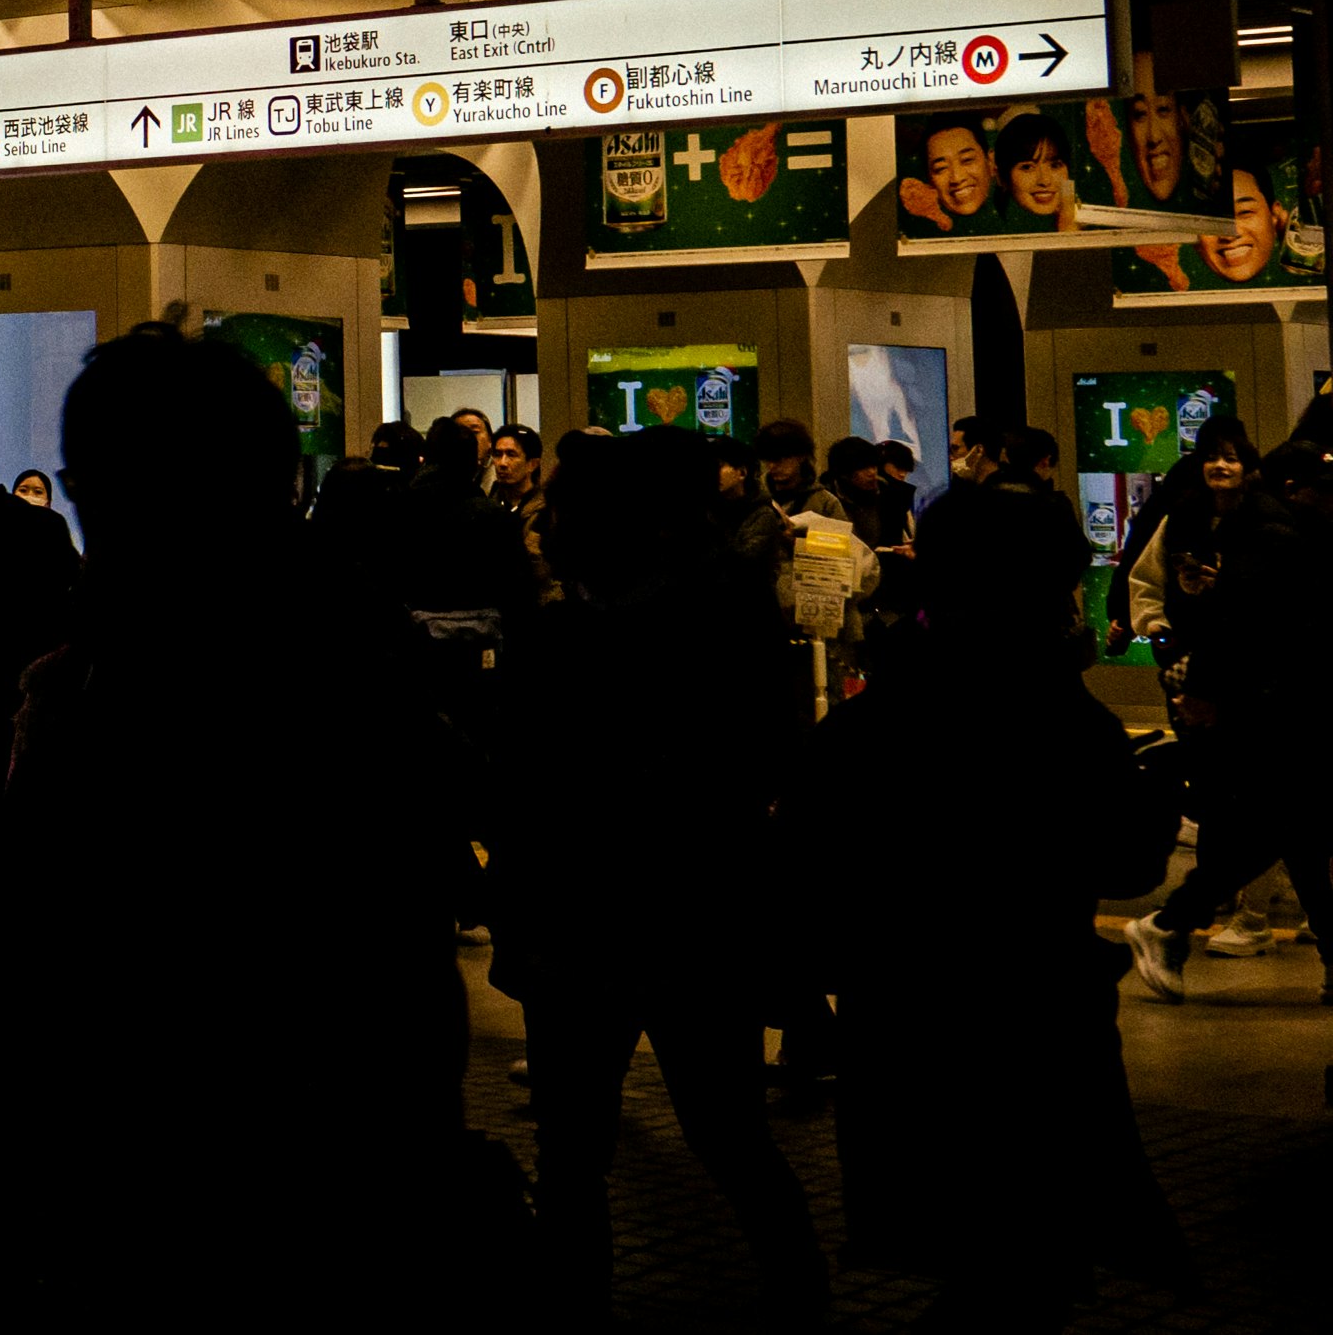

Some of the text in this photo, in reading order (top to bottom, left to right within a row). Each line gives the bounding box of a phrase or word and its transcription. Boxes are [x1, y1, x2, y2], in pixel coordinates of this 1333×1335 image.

[324, 30, 379, 54] 池袋駅
[450, 37, 556, 61] East Exit (Cntrl)
[324, 51, 421, 71] Ikebukuro Sta.
[860, 40, 959, 71] 丸ノ内線
[975, 51, 995, 68] M
[627, 61, 716, 91] 副都心線
[814, 70, 959, 96] Marunouchi Line
[305, 86, 405, 115] 東武東上線
[452, 76, 535, 104] 有楽町線
[599, 83, 609, 99] F
[627, 88, 753, 111] Fukutoshin Line
[207, 98, 256, 122] JR 線
[273, 107, 296, 123] TJ
[425, 98, 435, 113] Y
[453, 102, 567, 124] Yurakucho Line
[4, 112, 90, 139] 西武池袋線
[177, 113, 197, 135] JR
[207, 124, 260, 142] JR Lines
[305, 115, 373, 134] Tobu Line
[4, 138, 67, 157] Seibu Line
[606, 132, 660, 155] Asahi
[616, 380, 645, 433] I
[1102, 401, 1129, 447] I
